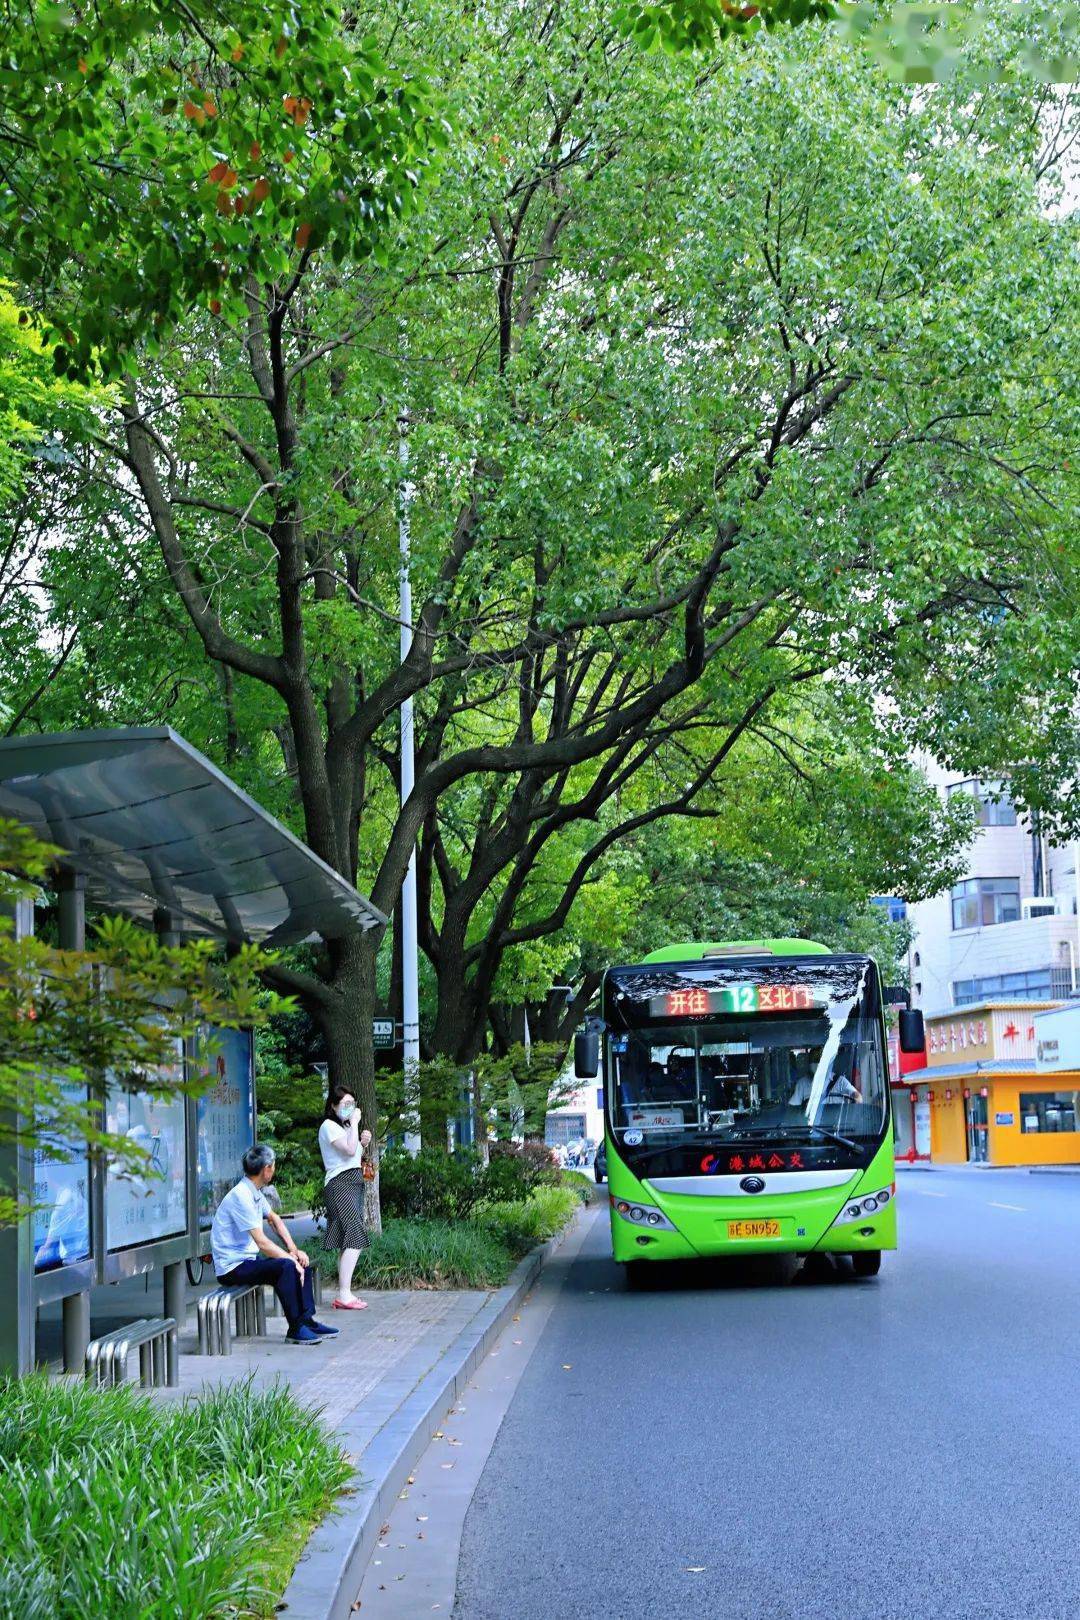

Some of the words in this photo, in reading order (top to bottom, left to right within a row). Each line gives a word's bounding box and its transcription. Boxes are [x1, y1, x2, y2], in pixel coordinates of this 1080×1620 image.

[670, 993, 706, 1013] 开往
[730, 987, 756, 1012] 12
[758, 986, 814, 1010] 区北门
[729, 1152, 804, 1171] 港城公交
